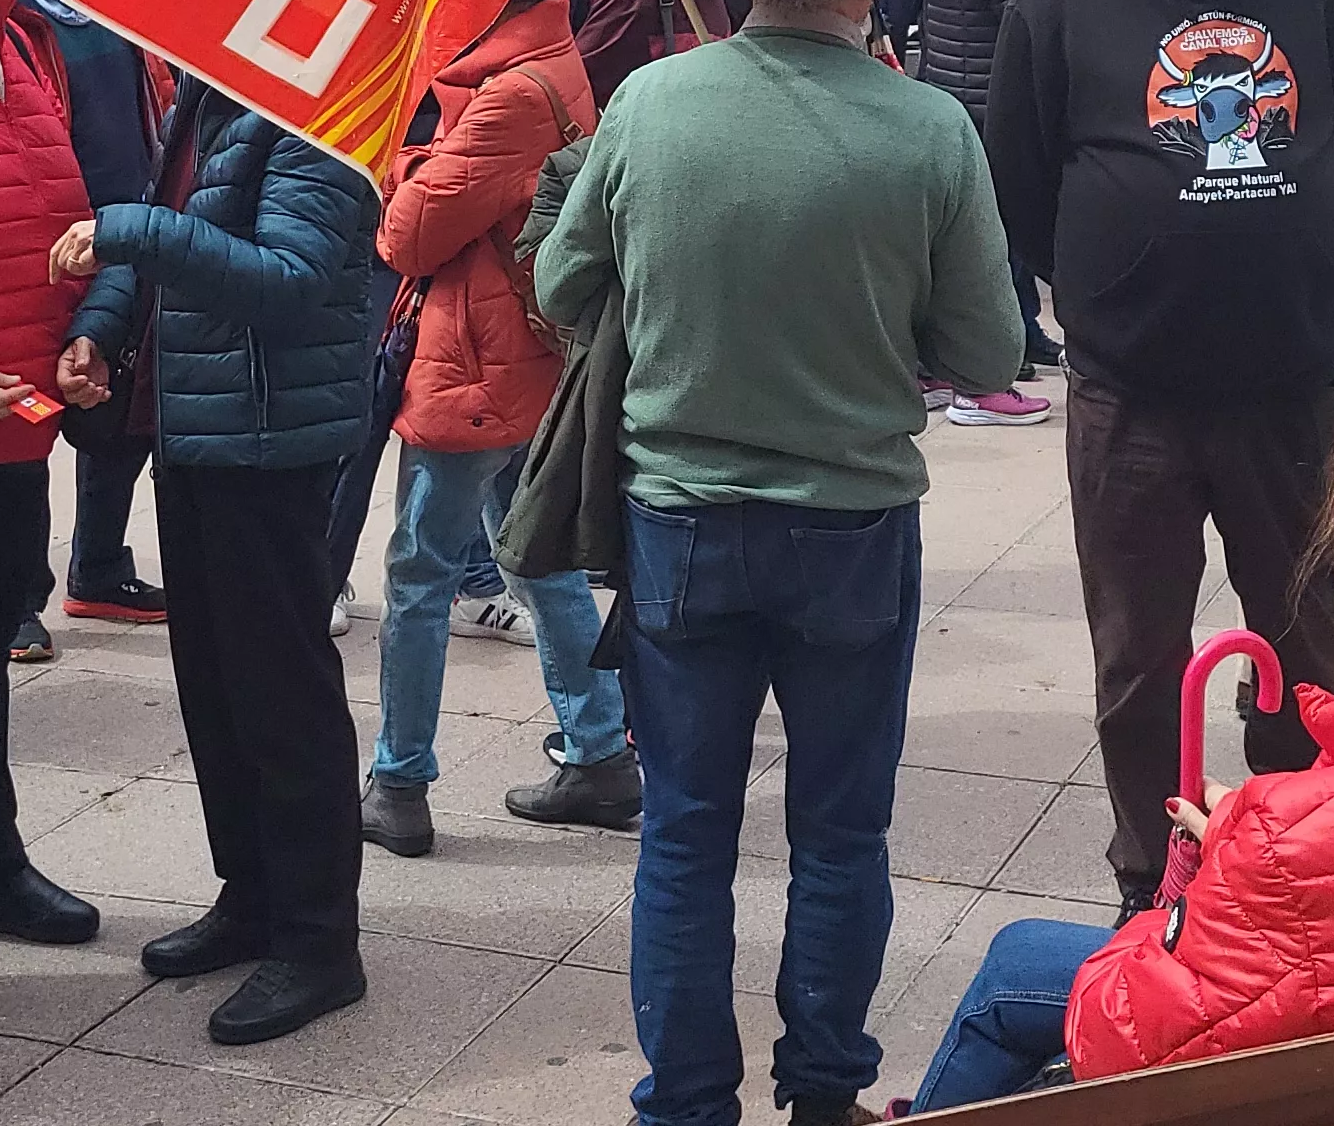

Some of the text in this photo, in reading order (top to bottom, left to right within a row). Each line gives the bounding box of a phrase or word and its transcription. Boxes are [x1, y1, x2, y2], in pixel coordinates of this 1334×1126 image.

[1160, 34, 1172, 47] NO
[1171, 18, 1197, 36] UNIÓ
[1184, 27, 1248, 43] ¡SALVEMOS
[1180, 34, 1256, 51] CANAL ROYA!
[1193, 171, 1284, 190] ¡Parque Natural
[1179, 182, 1297, 204] Anayet-Partacua YA!
